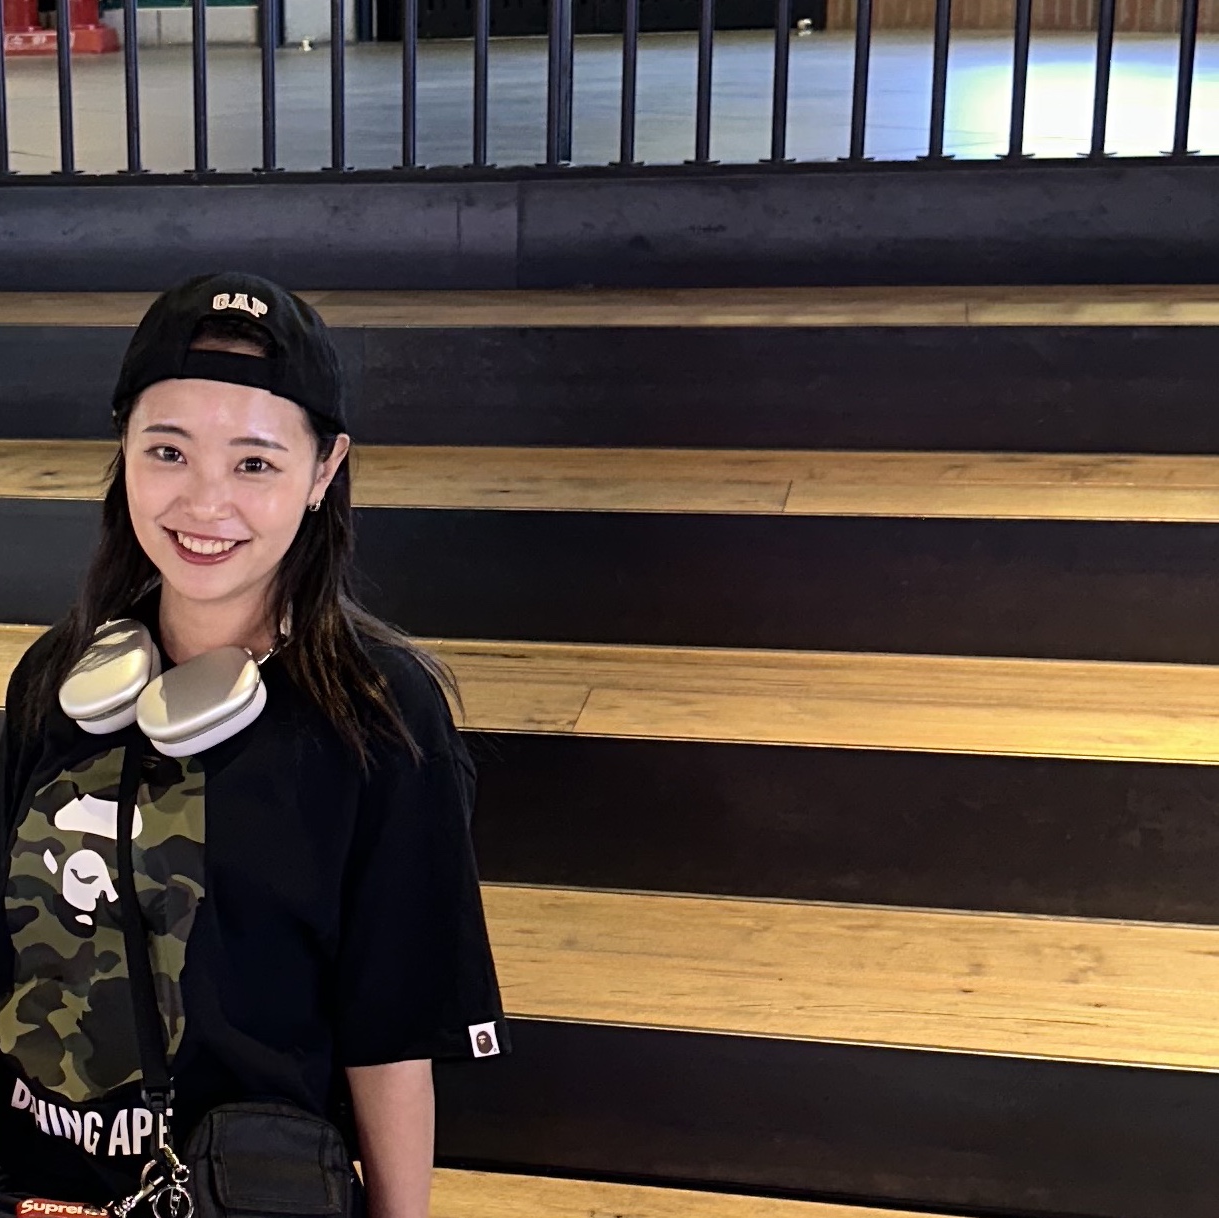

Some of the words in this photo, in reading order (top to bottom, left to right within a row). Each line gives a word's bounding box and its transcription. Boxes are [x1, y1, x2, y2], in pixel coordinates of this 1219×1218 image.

[212, 293, 268, 318] GAP
[11, 1077, 103, 1156] HING
[108, 1108, 173, 1156] APE
